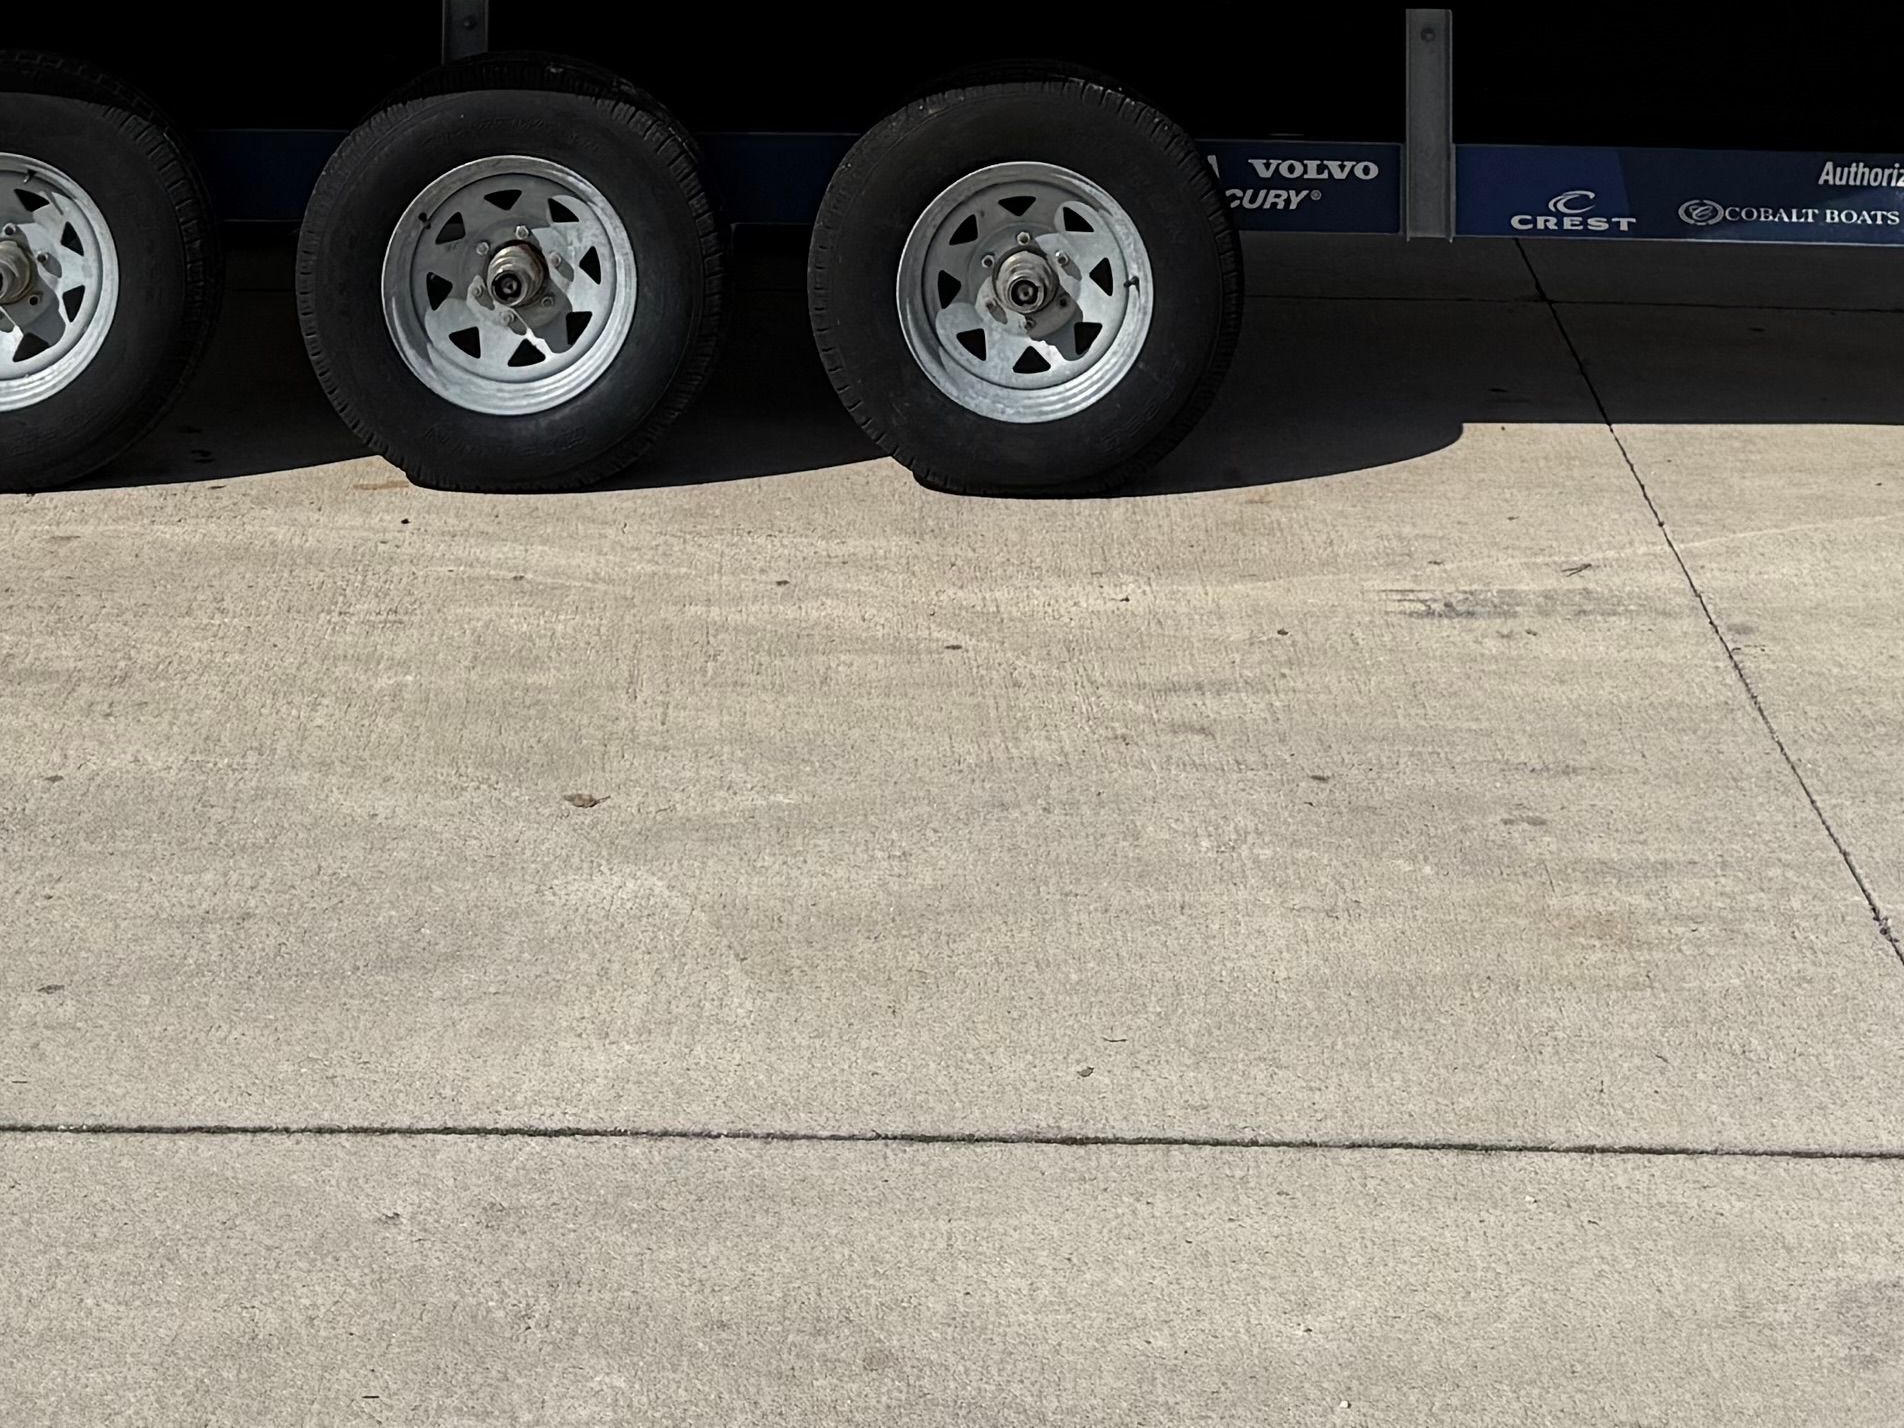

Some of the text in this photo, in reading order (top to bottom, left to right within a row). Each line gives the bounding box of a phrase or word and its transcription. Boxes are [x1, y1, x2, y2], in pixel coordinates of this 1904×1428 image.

[1247, 158, 1379, 181] VOLVO
[1510, 215, 1637, 232] CREST
[1724, 206, 1901, 225] COBALT BOATS
